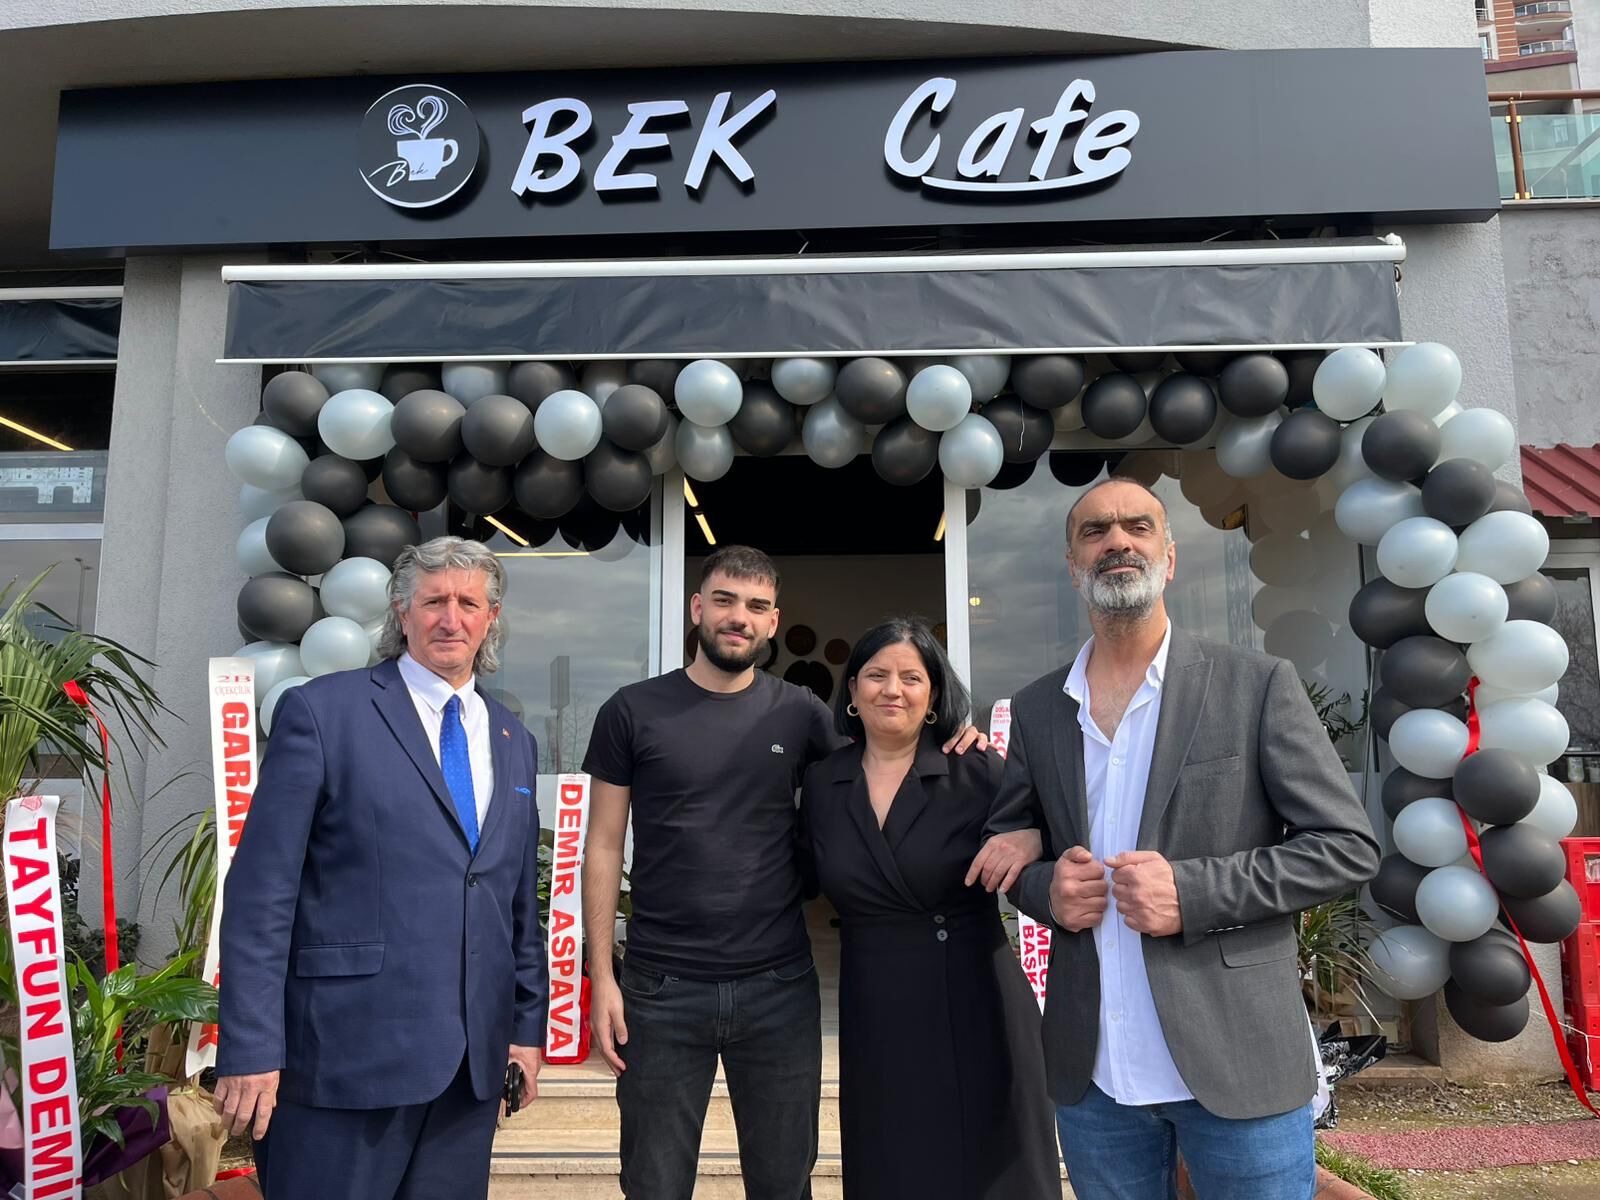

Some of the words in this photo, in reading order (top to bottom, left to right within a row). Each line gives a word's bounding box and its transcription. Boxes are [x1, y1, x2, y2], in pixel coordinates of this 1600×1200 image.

[368, 159, 429, 187] Bek
[510, 88, 777, 198] BEK
[884, 76, 1141, 193] Cafe
[216, 674, 252, 683] 2B
[553, 783, 583, 898] DEMİR
[8, 816, 65, 1041] TAYFUN
[549, 908, 577, 1053] ASPAVA
[1022, 924, 1039, 1000] BAŞK
[28, 1055, 84, 1200] DEMİ
